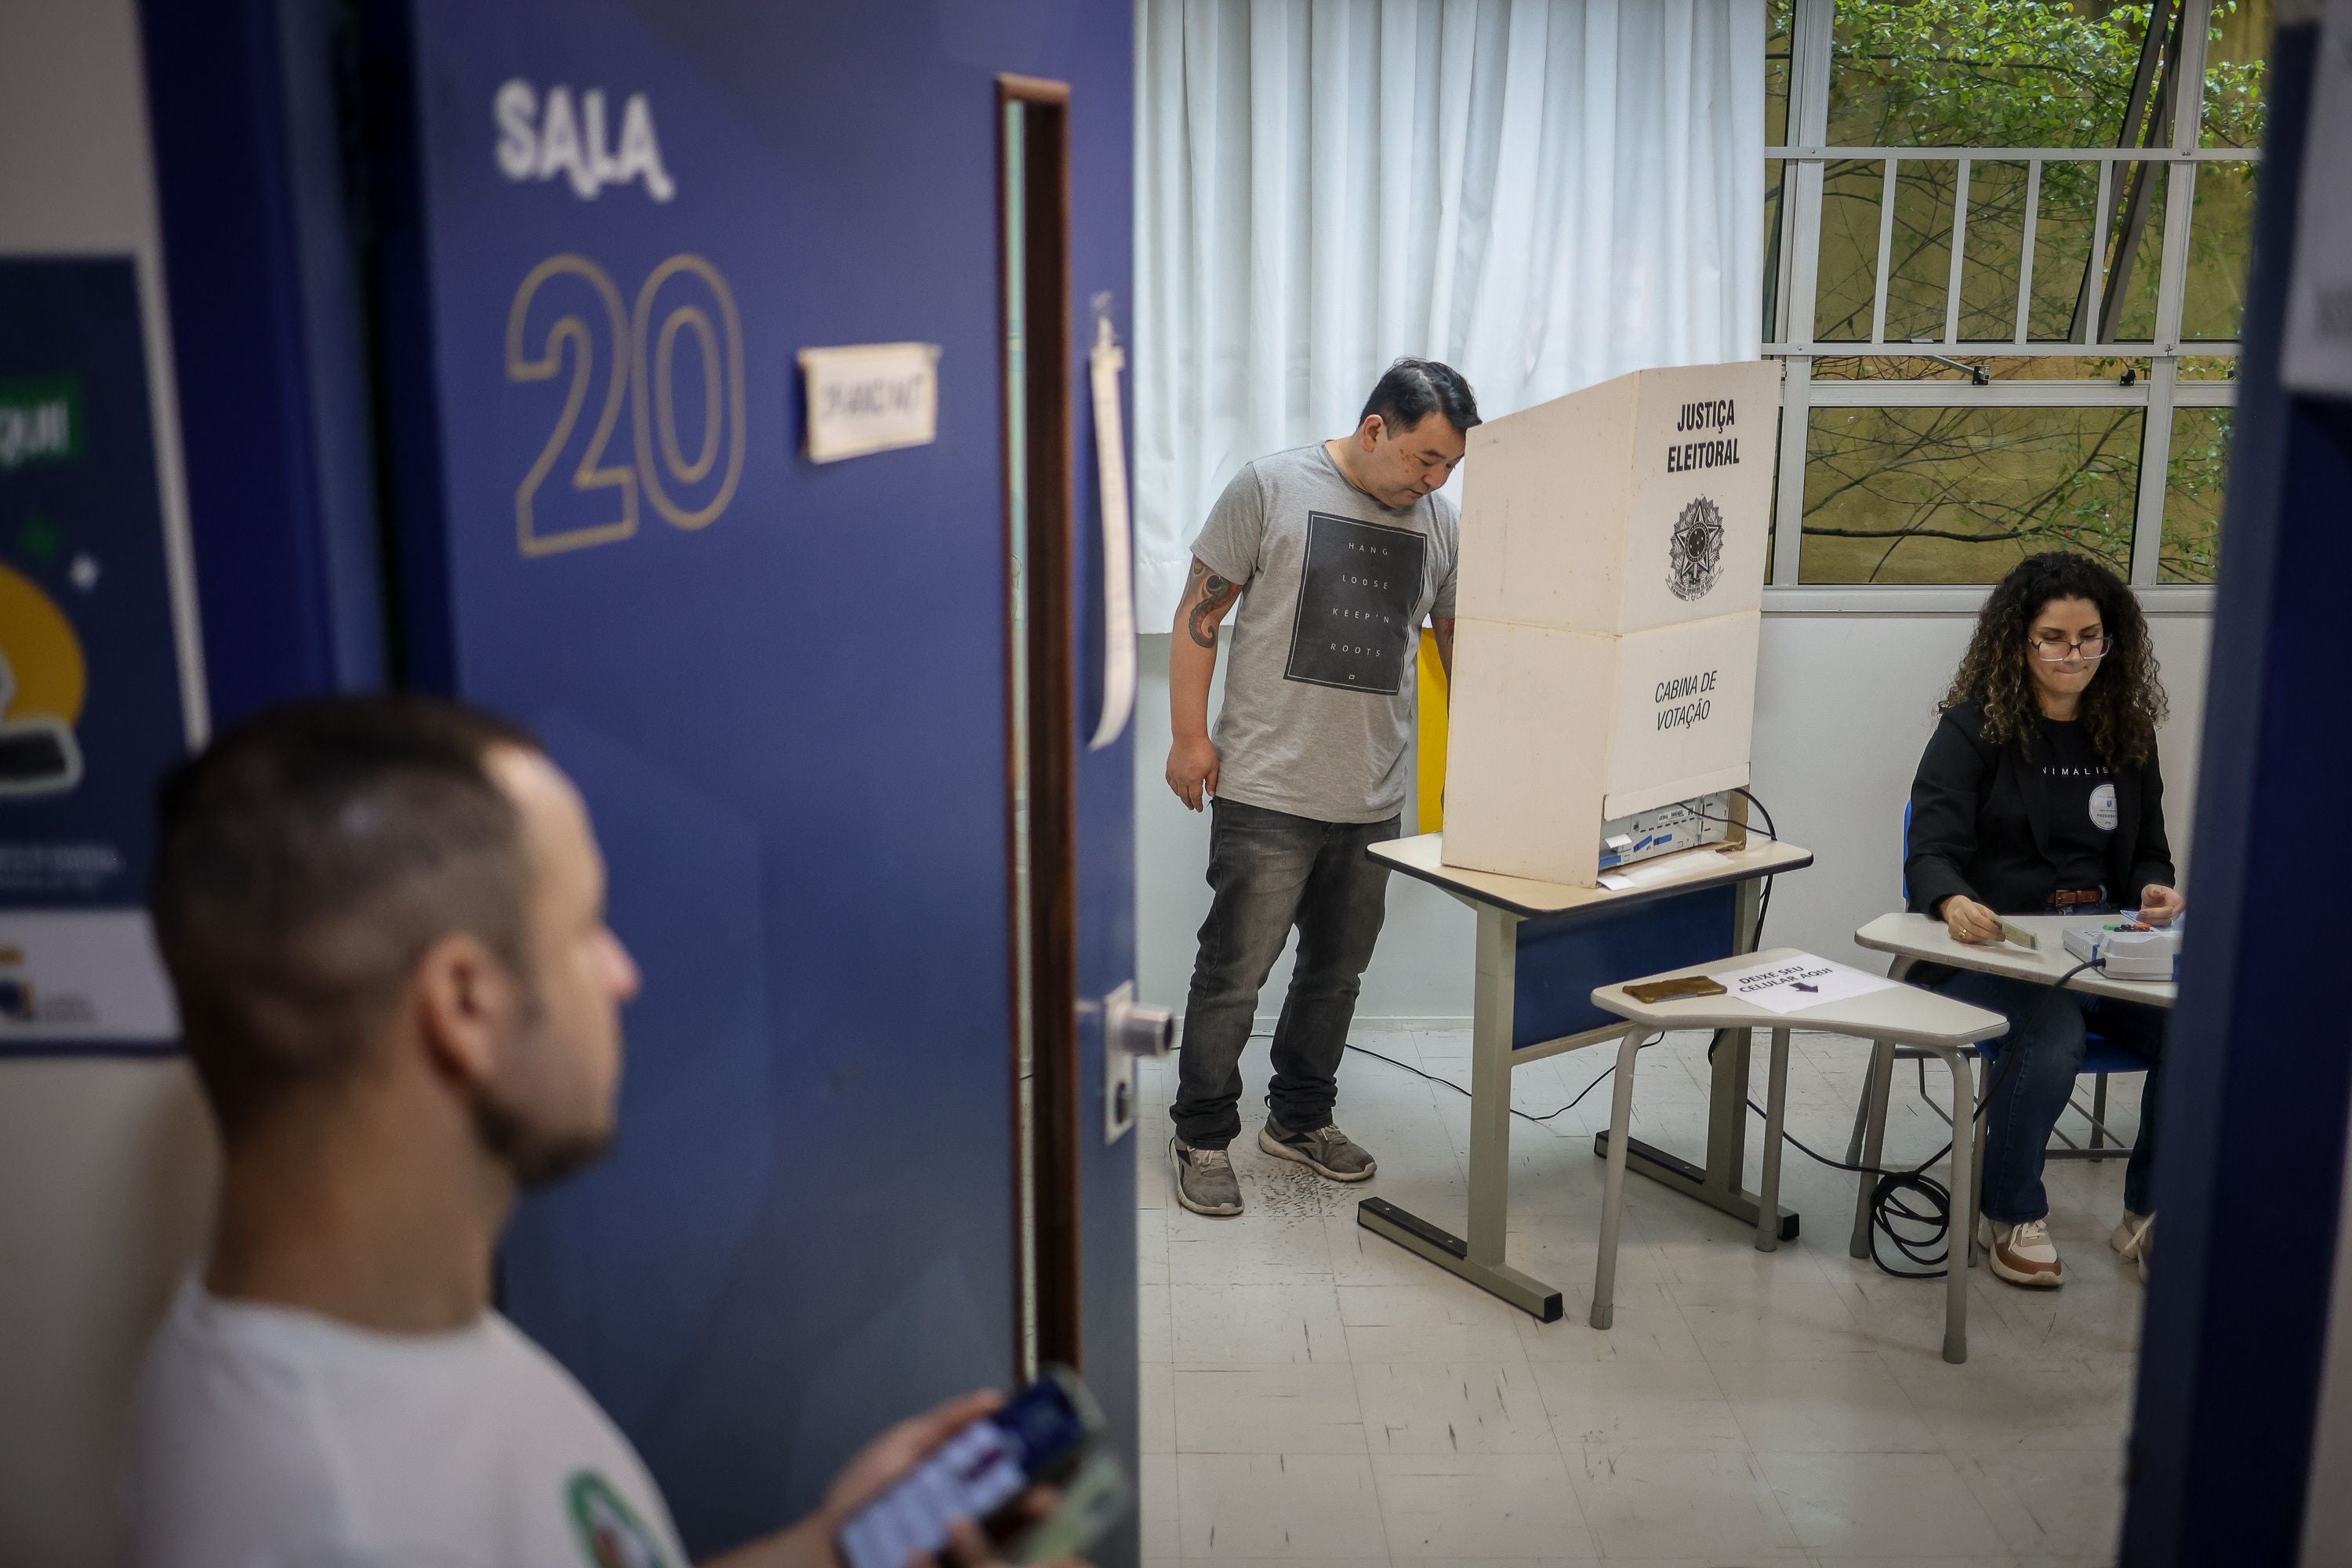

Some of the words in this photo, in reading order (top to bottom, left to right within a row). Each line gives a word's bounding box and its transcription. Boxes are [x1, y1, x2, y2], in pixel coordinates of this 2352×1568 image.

[495, 80, 673, 201] SALA
[507, 255, 745, 555] 20
[1677, 399, 1735, 434] JUSTIÇA
[1668, 438, 1740, 473] ELEITORAL
[1348, 543, 1388, 555] HANG
[1342, 575, 1388, 590] LOOSE
[1333, 608, 1389, 623] KEEP'N
[1330, 643, 1381, 657] ROOTS
[1655, 675, 1697, 703] CABINA
[1700, 670, 1717, 692] DE
[1657, 699, 1711, 731] VOTAÇÃO
[1738, 972, 1779, 984] DEIXE
[1778, 966, 1804, 975] SEU
[1740, 976, 1798, 993] CELULAR
[1800, 967, 1833, 979] AQUI
